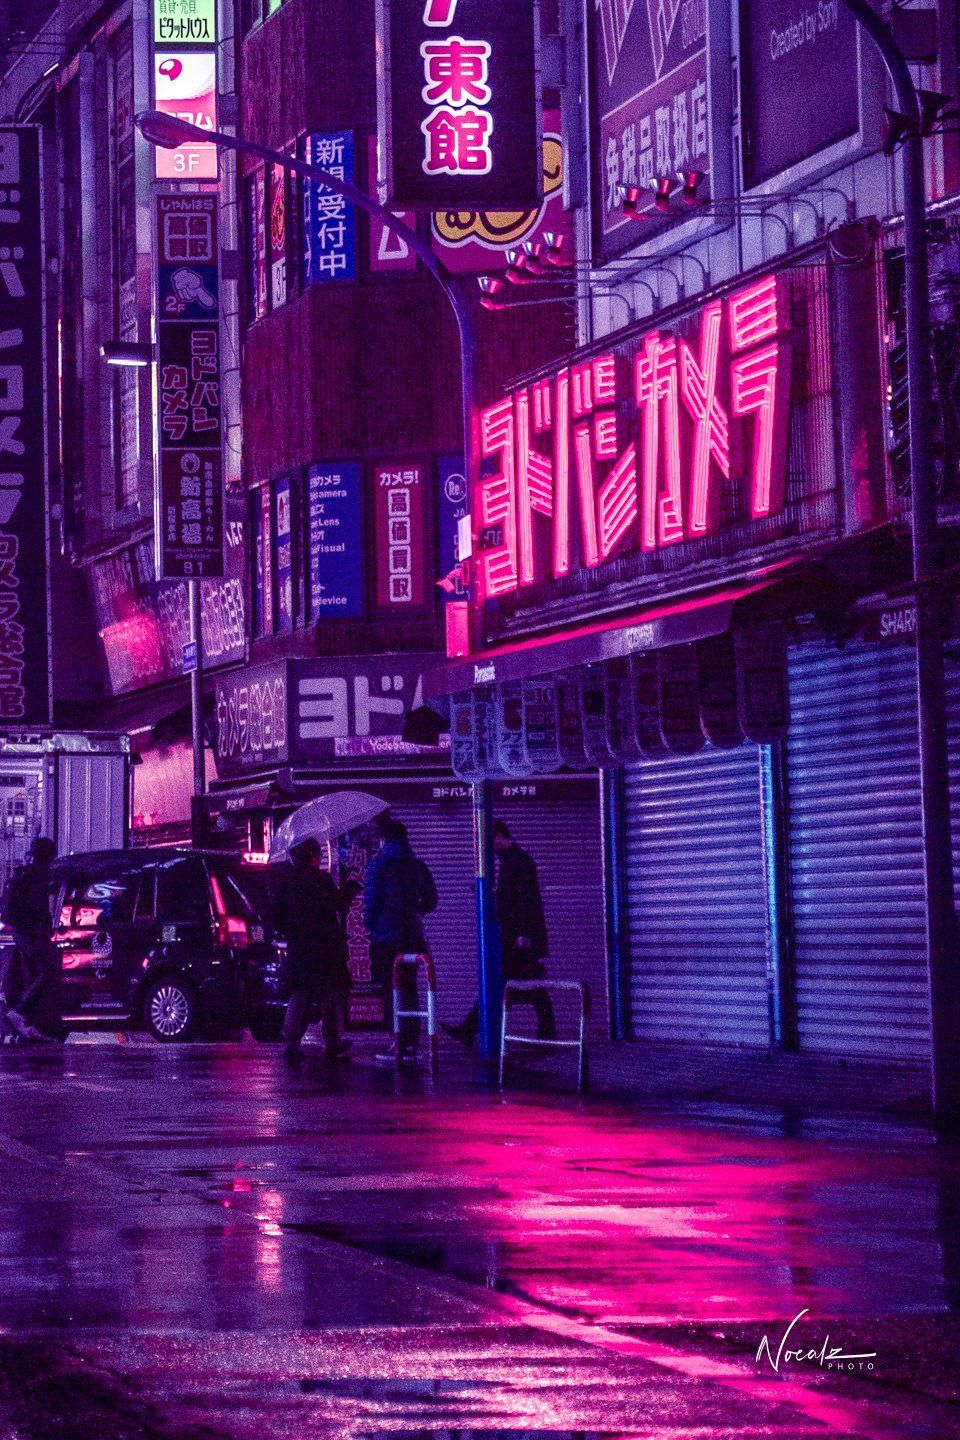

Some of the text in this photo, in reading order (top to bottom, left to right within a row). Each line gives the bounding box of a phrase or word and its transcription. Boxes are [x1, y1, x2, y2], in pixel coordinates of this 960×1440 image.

[158, 17, 210, 39] ピタットハウス
[770, 12, 805, 61] Created
[805, 8, 817, 46] by
[421, 34, 494, 175] 東館
[172, 152, 200, 173] 3F
[162, 363, 190, 441] カメラ
[190, 329, 219, 433] ヨドバシ
[379, 469, 420, 486] カメラ!
